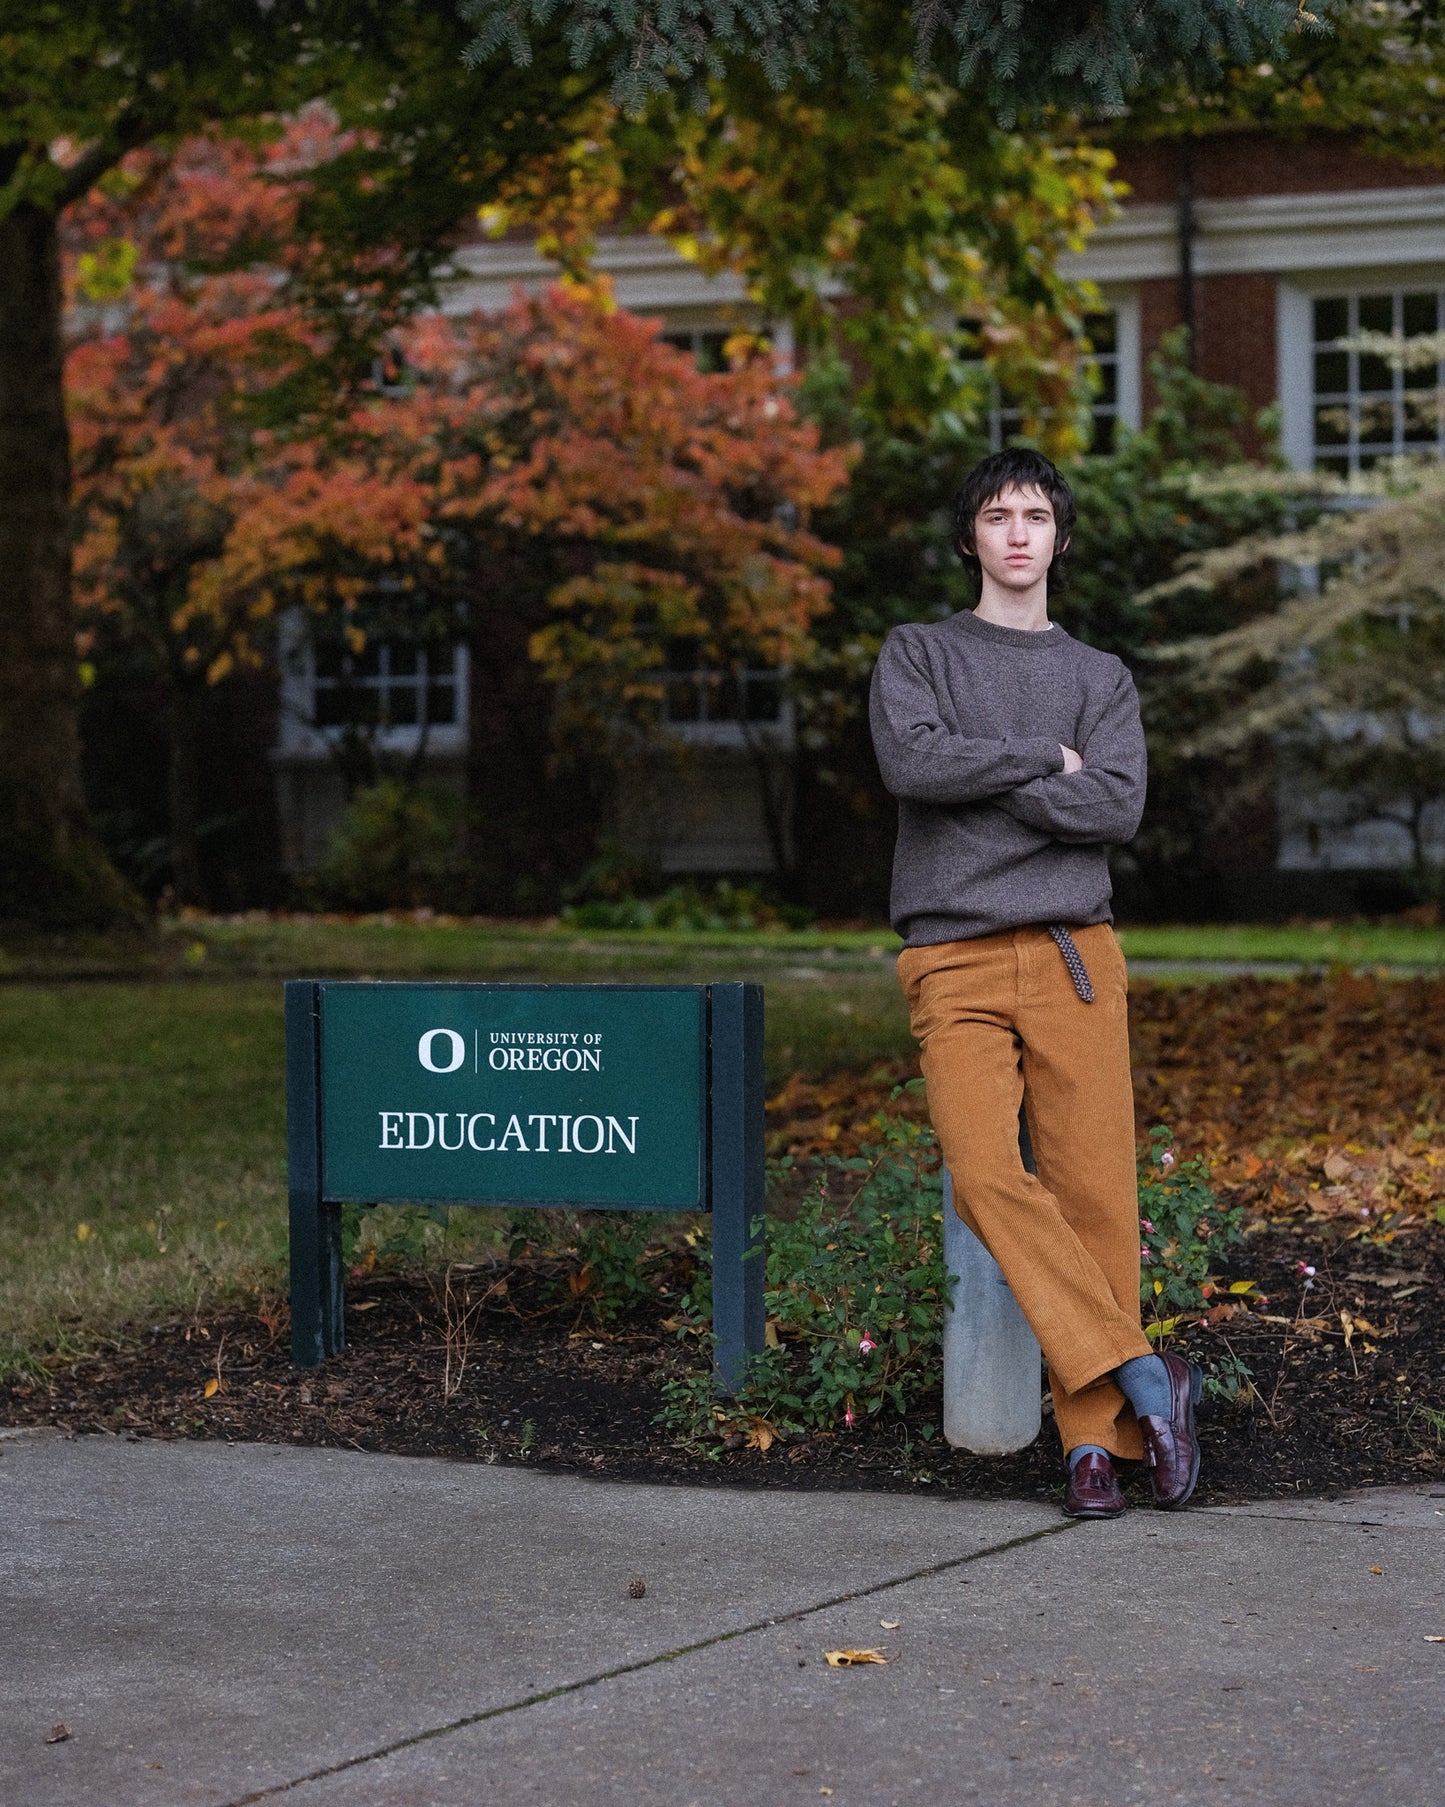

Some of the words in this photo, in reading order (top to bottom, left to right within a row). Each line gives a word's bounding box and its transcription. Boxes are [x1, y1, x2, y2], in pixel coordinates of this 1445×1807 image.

[418, 1028, 466, 1074] O
[489, 1032, 580, 1045] UNIVERSITY
[583, 1033, 603, 1045] OF
[488, 1047, 602, 1072] OREGON
[378, 1111, 640, 1154] EDUCATION
